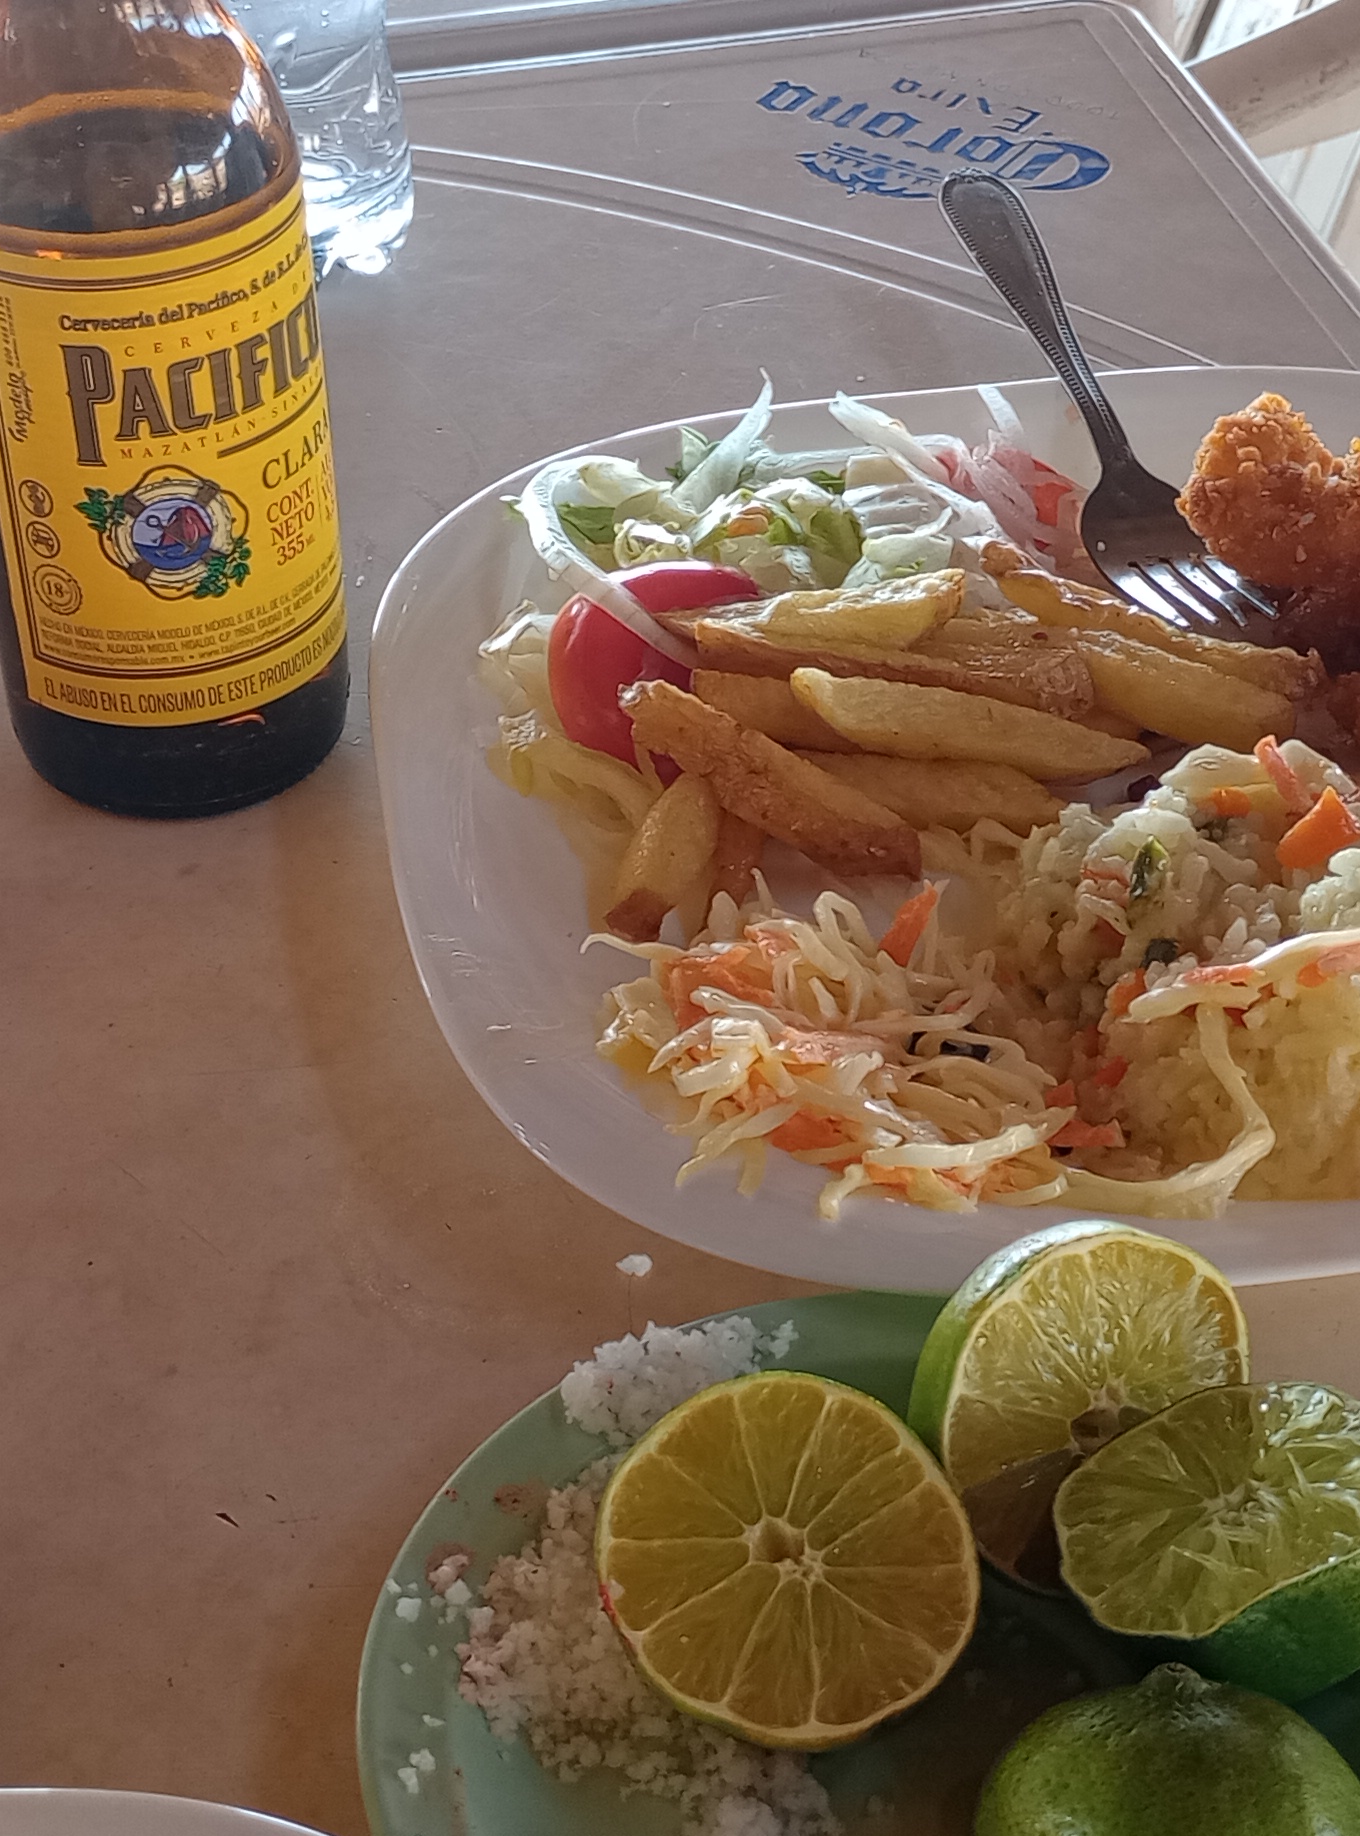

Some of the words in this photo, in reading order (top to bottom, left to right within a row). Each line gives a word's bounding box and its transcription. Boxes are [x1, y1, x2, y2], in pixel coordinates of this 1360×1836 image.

[755, 80, 1112, 191] Corona
[60, 311, 156, 332] Cervecería
[158, 303, 183, 325] del
[263, 270, 276, 287] de
[124, 301, 279, 357] CERVEZA
[267, 477, 315, 523] CONT.
[270, 501, 315, 547] NETO
[276, 531, 305, 567] 355
[192, 624, 204, 636] DE
[44, 677, 58, 699] EL
[59, 682, 98, 710] ABUSO
[101, 689, 118, 712] EN
[120, 693, 138, 714] EL
[138, 687, 205, 714] CONSUMO
[207, 684, 226, 707] DE
[227, 673, 258, 702] ESTE
[258, 647, 312, 691] PRODUCTO
